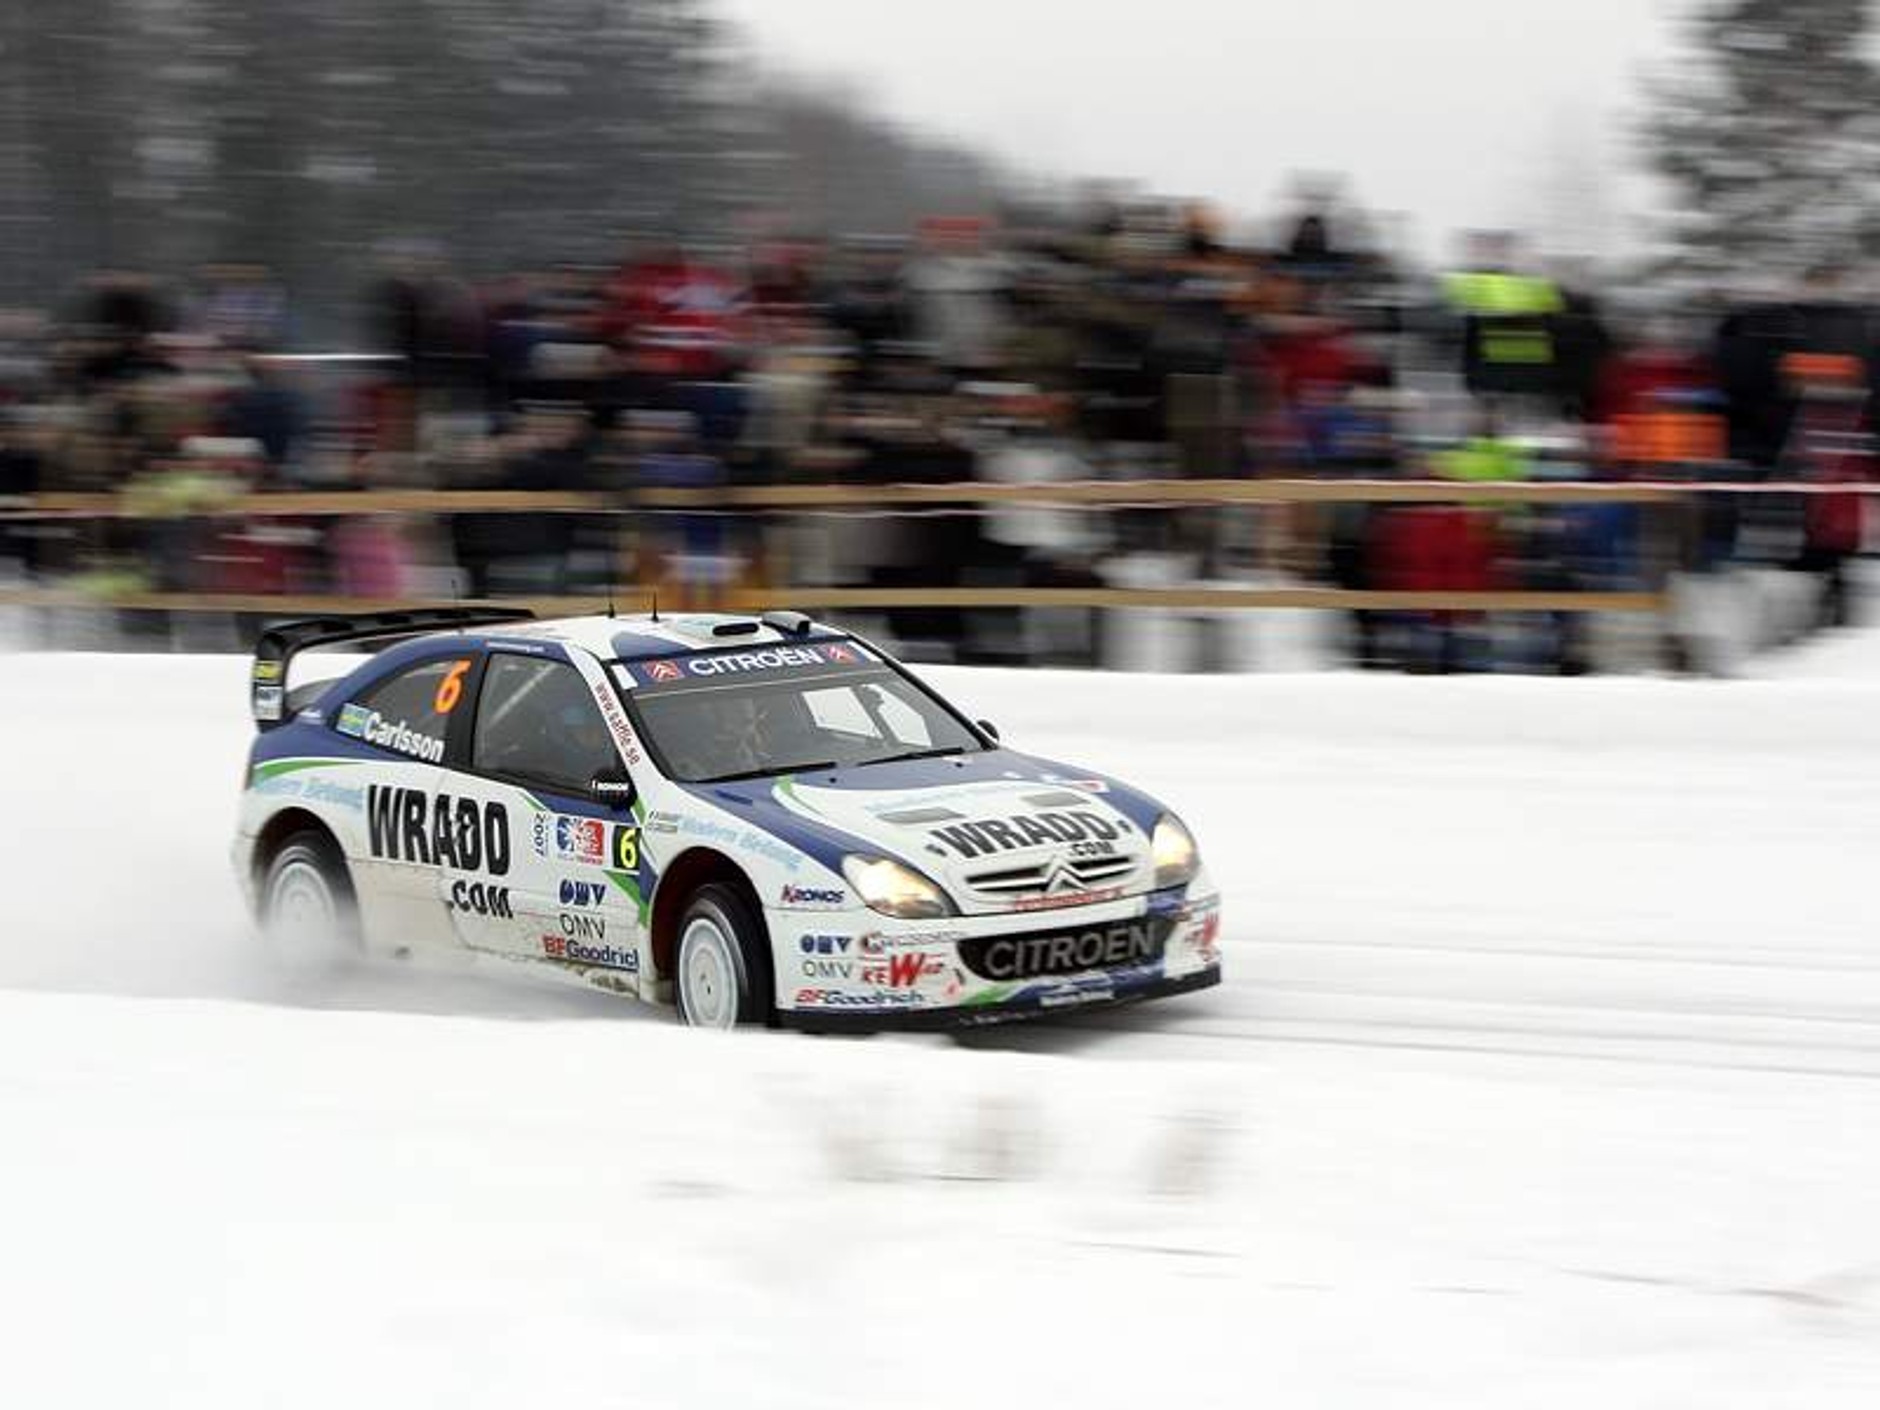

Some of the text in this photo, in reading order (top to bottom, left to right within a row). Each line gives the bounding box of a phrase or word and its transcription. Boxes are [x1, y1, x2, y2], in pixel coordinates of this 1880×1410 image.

[689, 647, 824, 675] CITROËN
[435, 660, 472, 714] 6
[363, 712, 445, 763] Carlsson
[533, 813, 545, 856] 2007
[620, 828, 637, 869] 6
[929, 812, 1119, 858] WRADD
[449, 880, 513, 919] .COM
[560, 914, 605, 939] OMV
[802, 960, 852, 978] OMV
